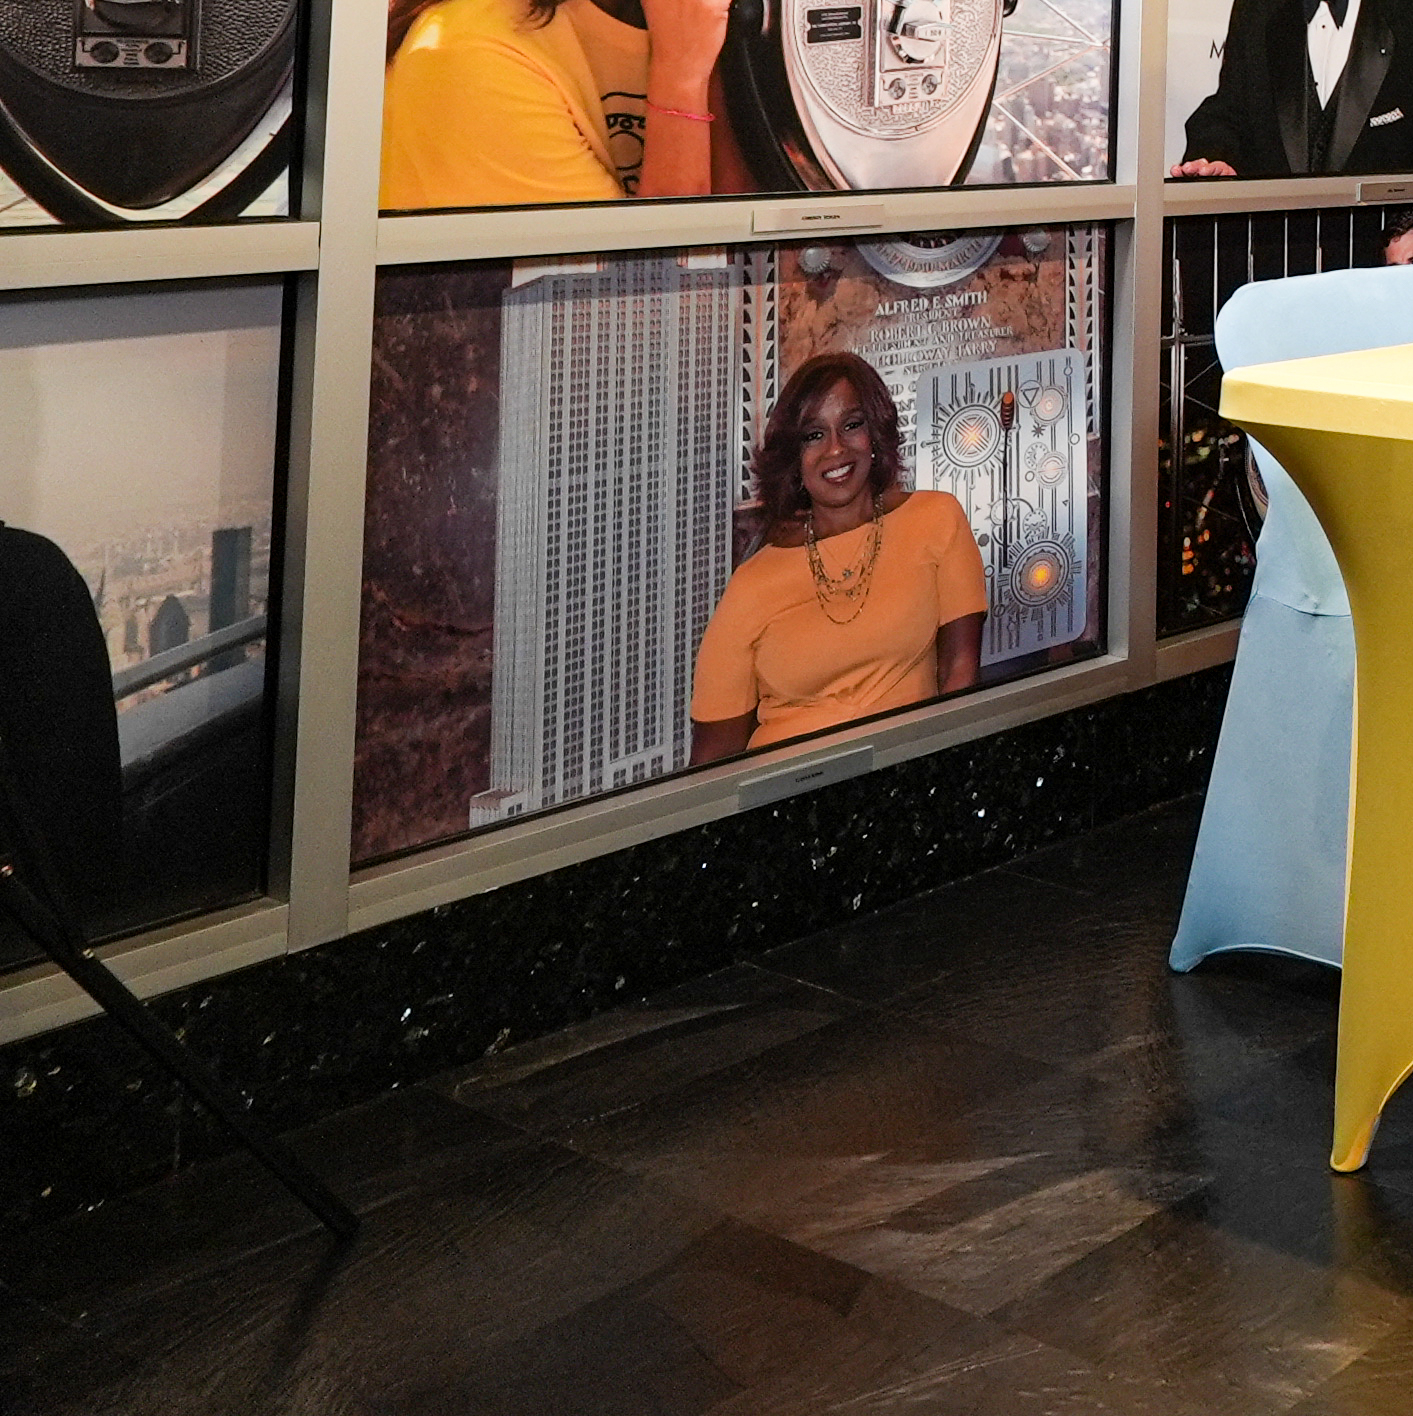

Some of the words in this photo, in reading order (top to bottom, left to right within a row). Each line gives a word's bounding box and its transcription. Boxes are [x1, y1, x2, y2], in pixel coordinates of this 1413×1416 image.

[874, 297, 929, 317] ALFRED
[944, 290, 988, 307] SMITH
[869, 323, 922, 344] ROBERT
[942, 315, 992, 334] BROWN
